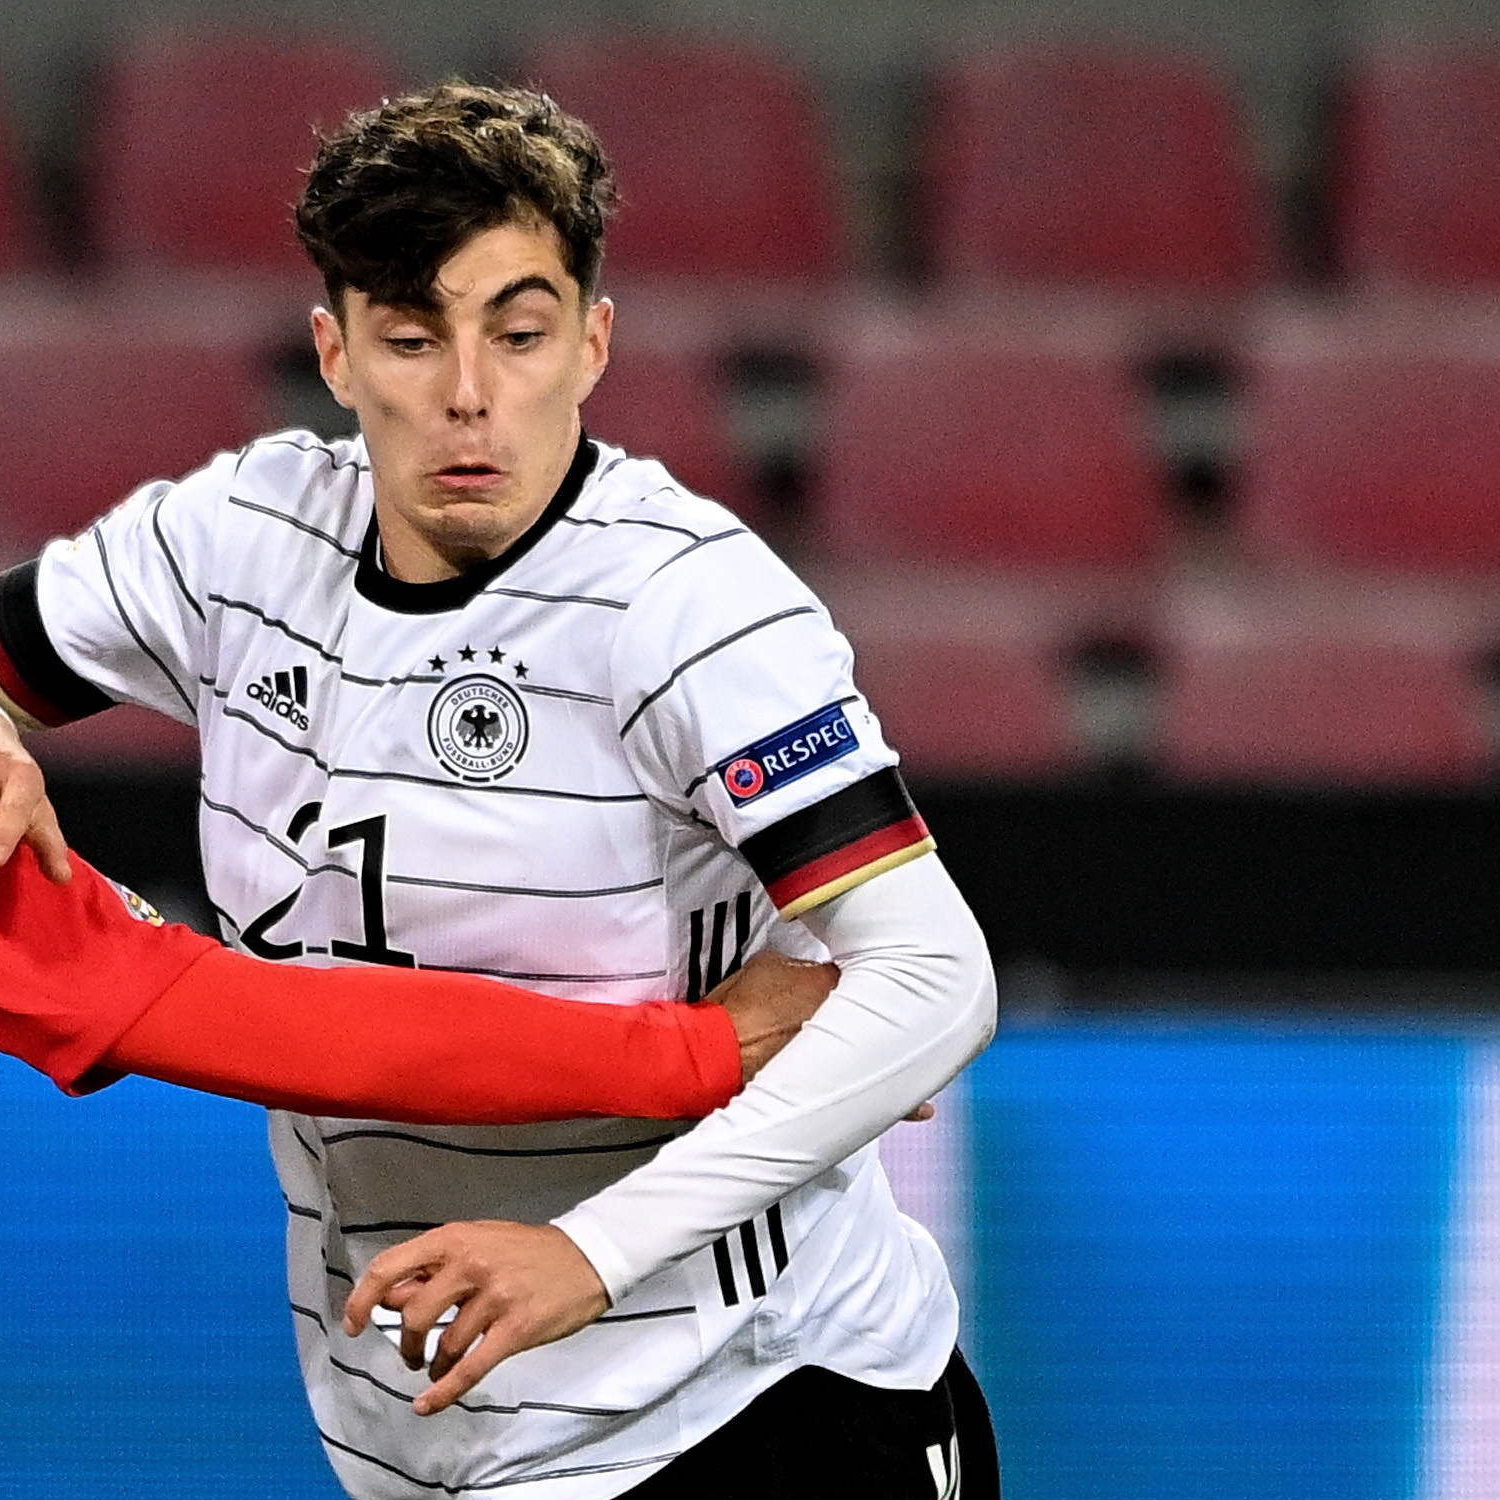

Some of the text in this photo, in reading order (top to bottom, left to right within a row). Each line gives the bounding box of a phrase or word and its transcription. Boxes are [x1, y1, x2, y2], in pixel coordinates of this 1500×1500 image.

[246, 683, 309, 731] adidas
[451, 687, 509, 709] DEUTSCHER
[240, 801, 417, 969] 21
